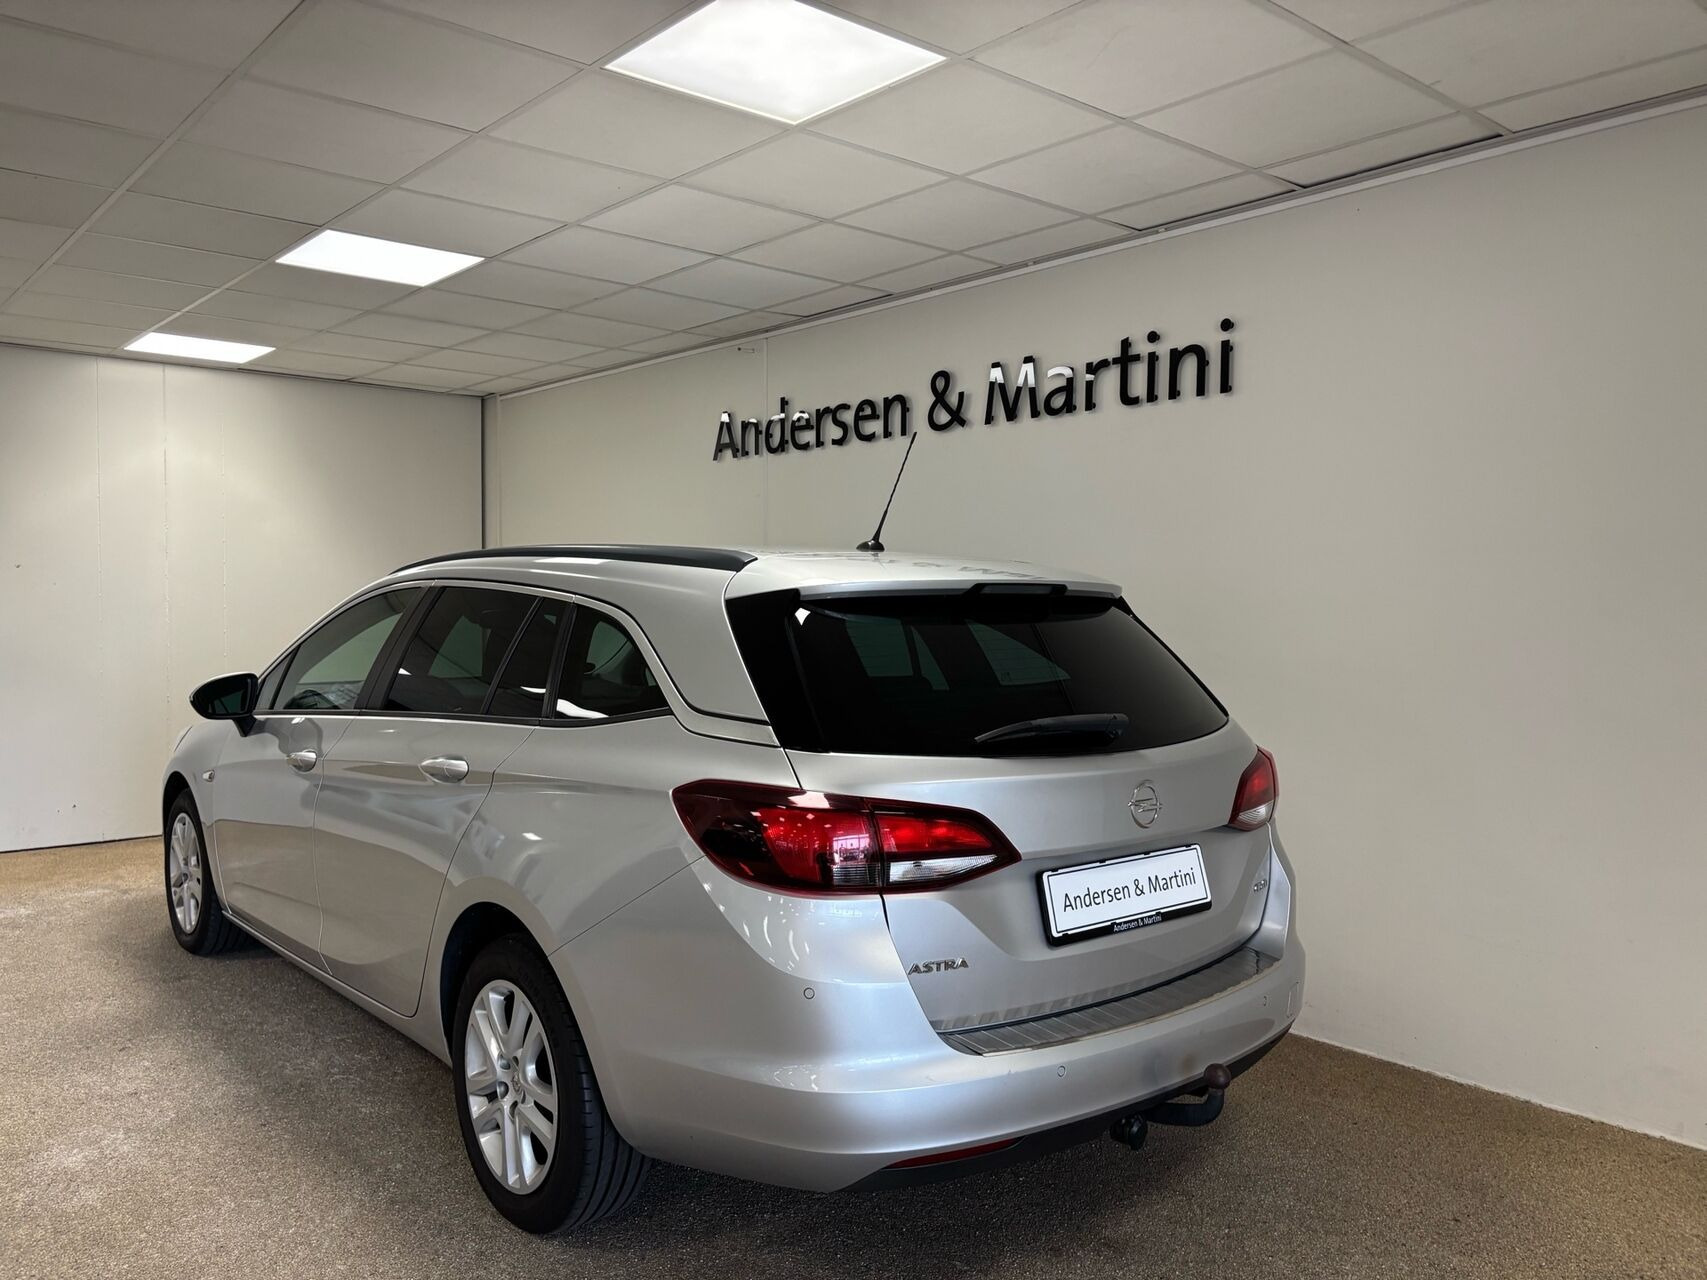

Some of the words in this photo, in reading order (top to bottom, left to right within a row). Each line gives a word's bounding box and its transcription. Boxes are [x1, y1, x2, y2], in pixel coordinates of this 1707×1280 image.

[713, 393, 912, 461] Andersen
[927, 369, 967, 432] &
[984, 318, 1236, 426] Martini
[1063, 884, 1131, 912] Andersen
[1134, 878, 1146, 897] &
[1148, 867, 1197, 894] Martini
[1113, 920, 1139, 932] Andersen
[908, 957, 969, 975] ASTRA
